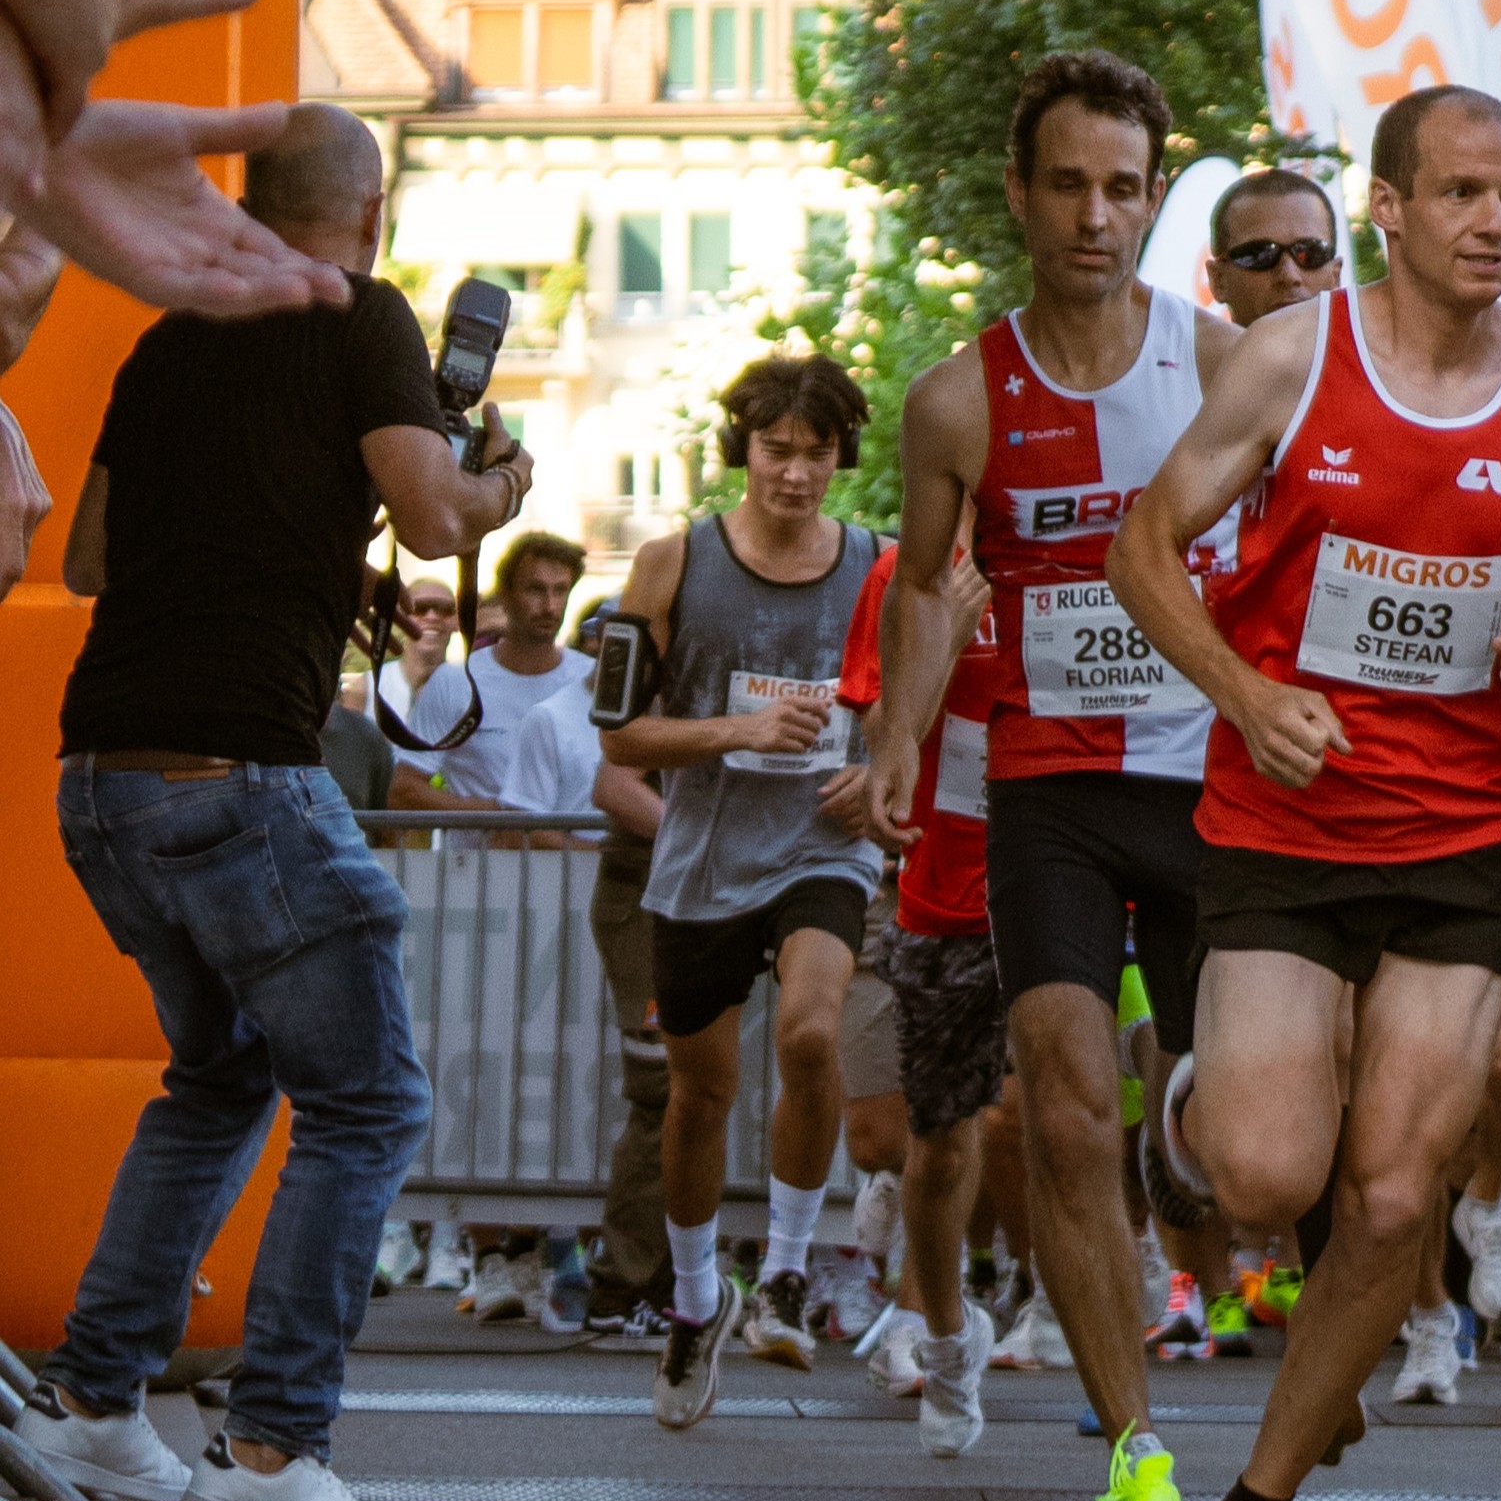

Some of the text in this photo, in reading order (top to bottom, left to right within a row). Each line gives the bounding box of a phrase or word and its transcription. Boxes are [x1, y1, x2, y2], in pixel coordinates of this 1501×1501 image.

[1307, 468, 1360, 486] erima
[1343, 543, 1492, 589] MIGROS
[1367, 595, 1454, 639] 663
[1073, 626, 1151, 664] 288
[1354, 634, 1454, 665] STEFAN
[1066, 665, 1164, 687] FLORIAN
[1358, 662, 1427, 680] THUNER
